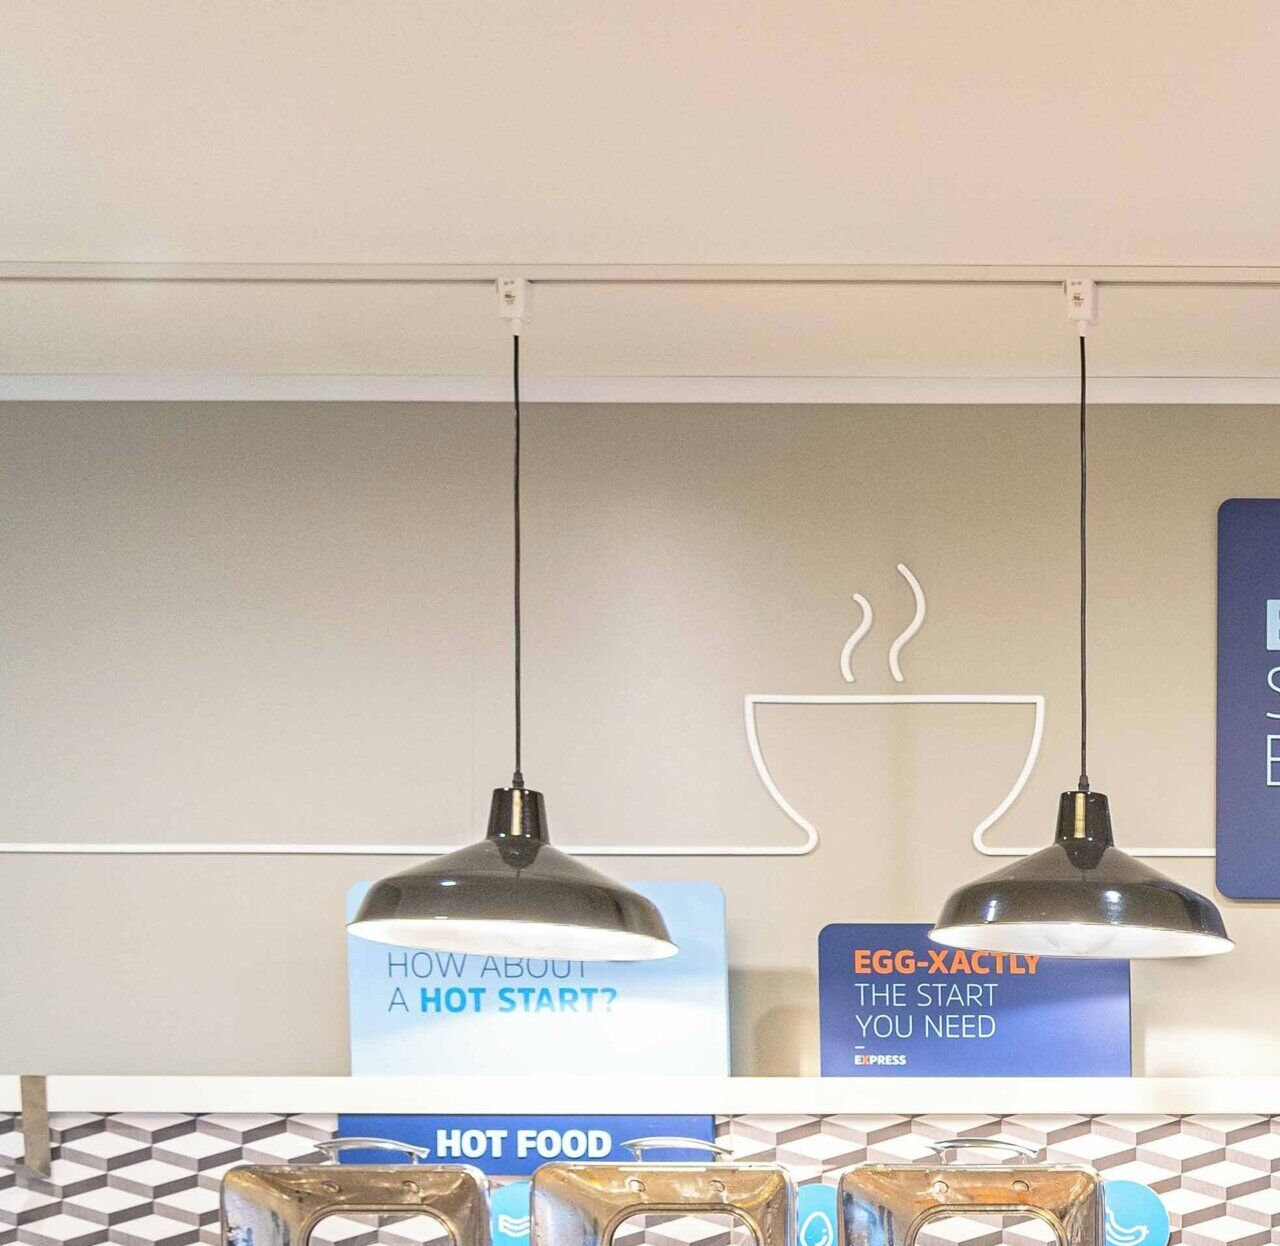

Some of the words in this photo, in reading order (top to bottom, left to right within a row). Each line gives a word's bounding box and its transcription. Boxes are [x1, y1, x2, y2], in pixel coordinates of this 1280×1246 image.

[387, 952, 467, 979] HOW
[480, 956, 586, 979] ABOUT
[854, 949, 1040, 975] EGG-XACTLY
[387, 987, 410, 1012] A
[420, 987, 486, 1013] HOT
[497, 987, 618, 1013] START?
[854, 983, 907, 1007] THE
[916, 983, 999, 1007] START
[854, 1014, 913, 1039] YOU
[925, 1014, 997, 1039] NEED
[854, 1054, 907, 1066] EXPRESS
[436, 1129, 509, 1158] HOT
[517, 1129, 612, 1158] FOOD
